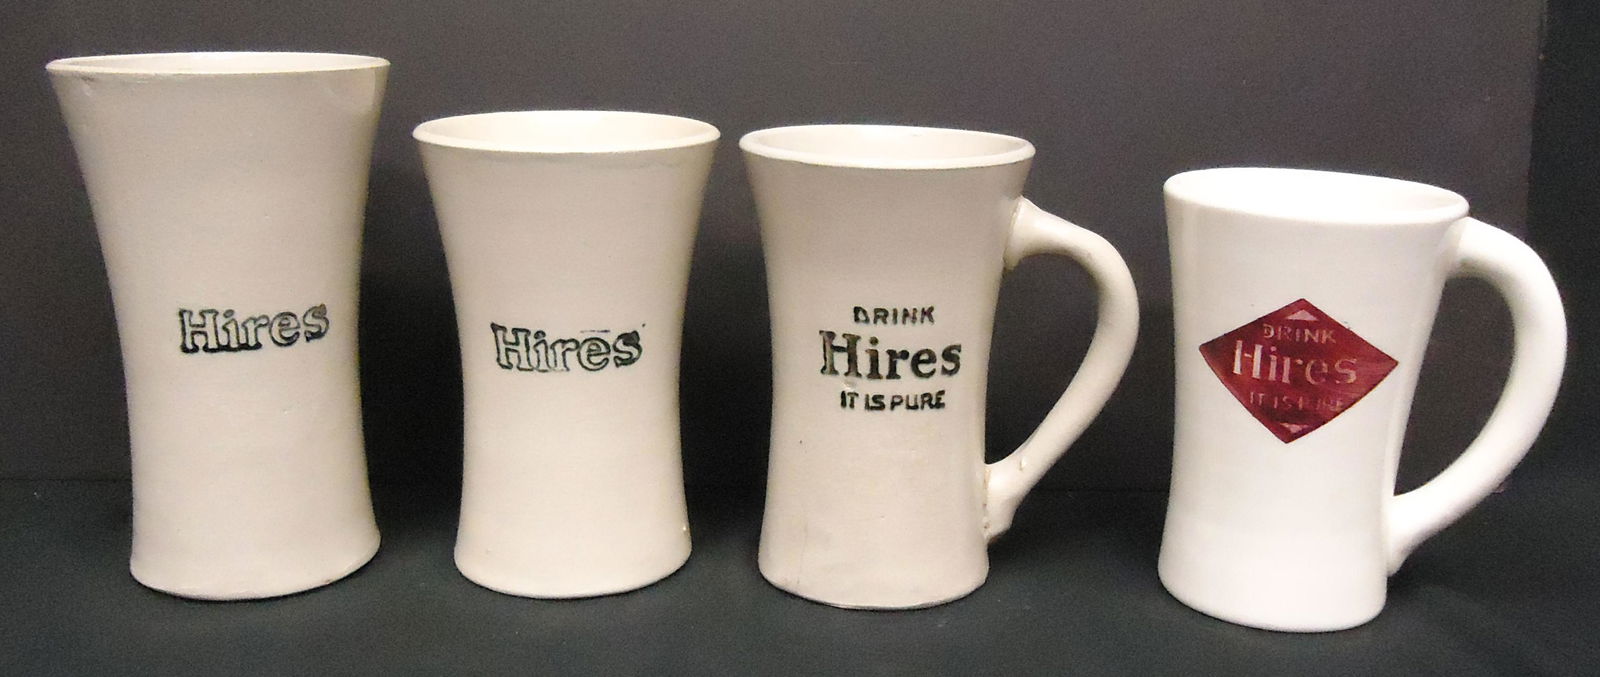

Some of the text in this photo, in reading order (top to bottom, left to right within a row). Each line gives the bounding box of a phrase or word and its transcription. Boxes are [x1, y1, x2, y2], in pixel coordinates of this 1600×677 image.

[179, 303, 329, 353] Hires
[853, 306, 935, 324] DRINK
[490, 322, 643, 373] Hires
[1262, 323, 1337, 344] DRINK
[819, 330, 962, 380] Hires
[1232, 339, 1358, 386] Hires
[840, 389, 946, 411] IT IS PURE
[1250, 391, 1265, 406] IT
[1273, 396, 1293, 409] IS
